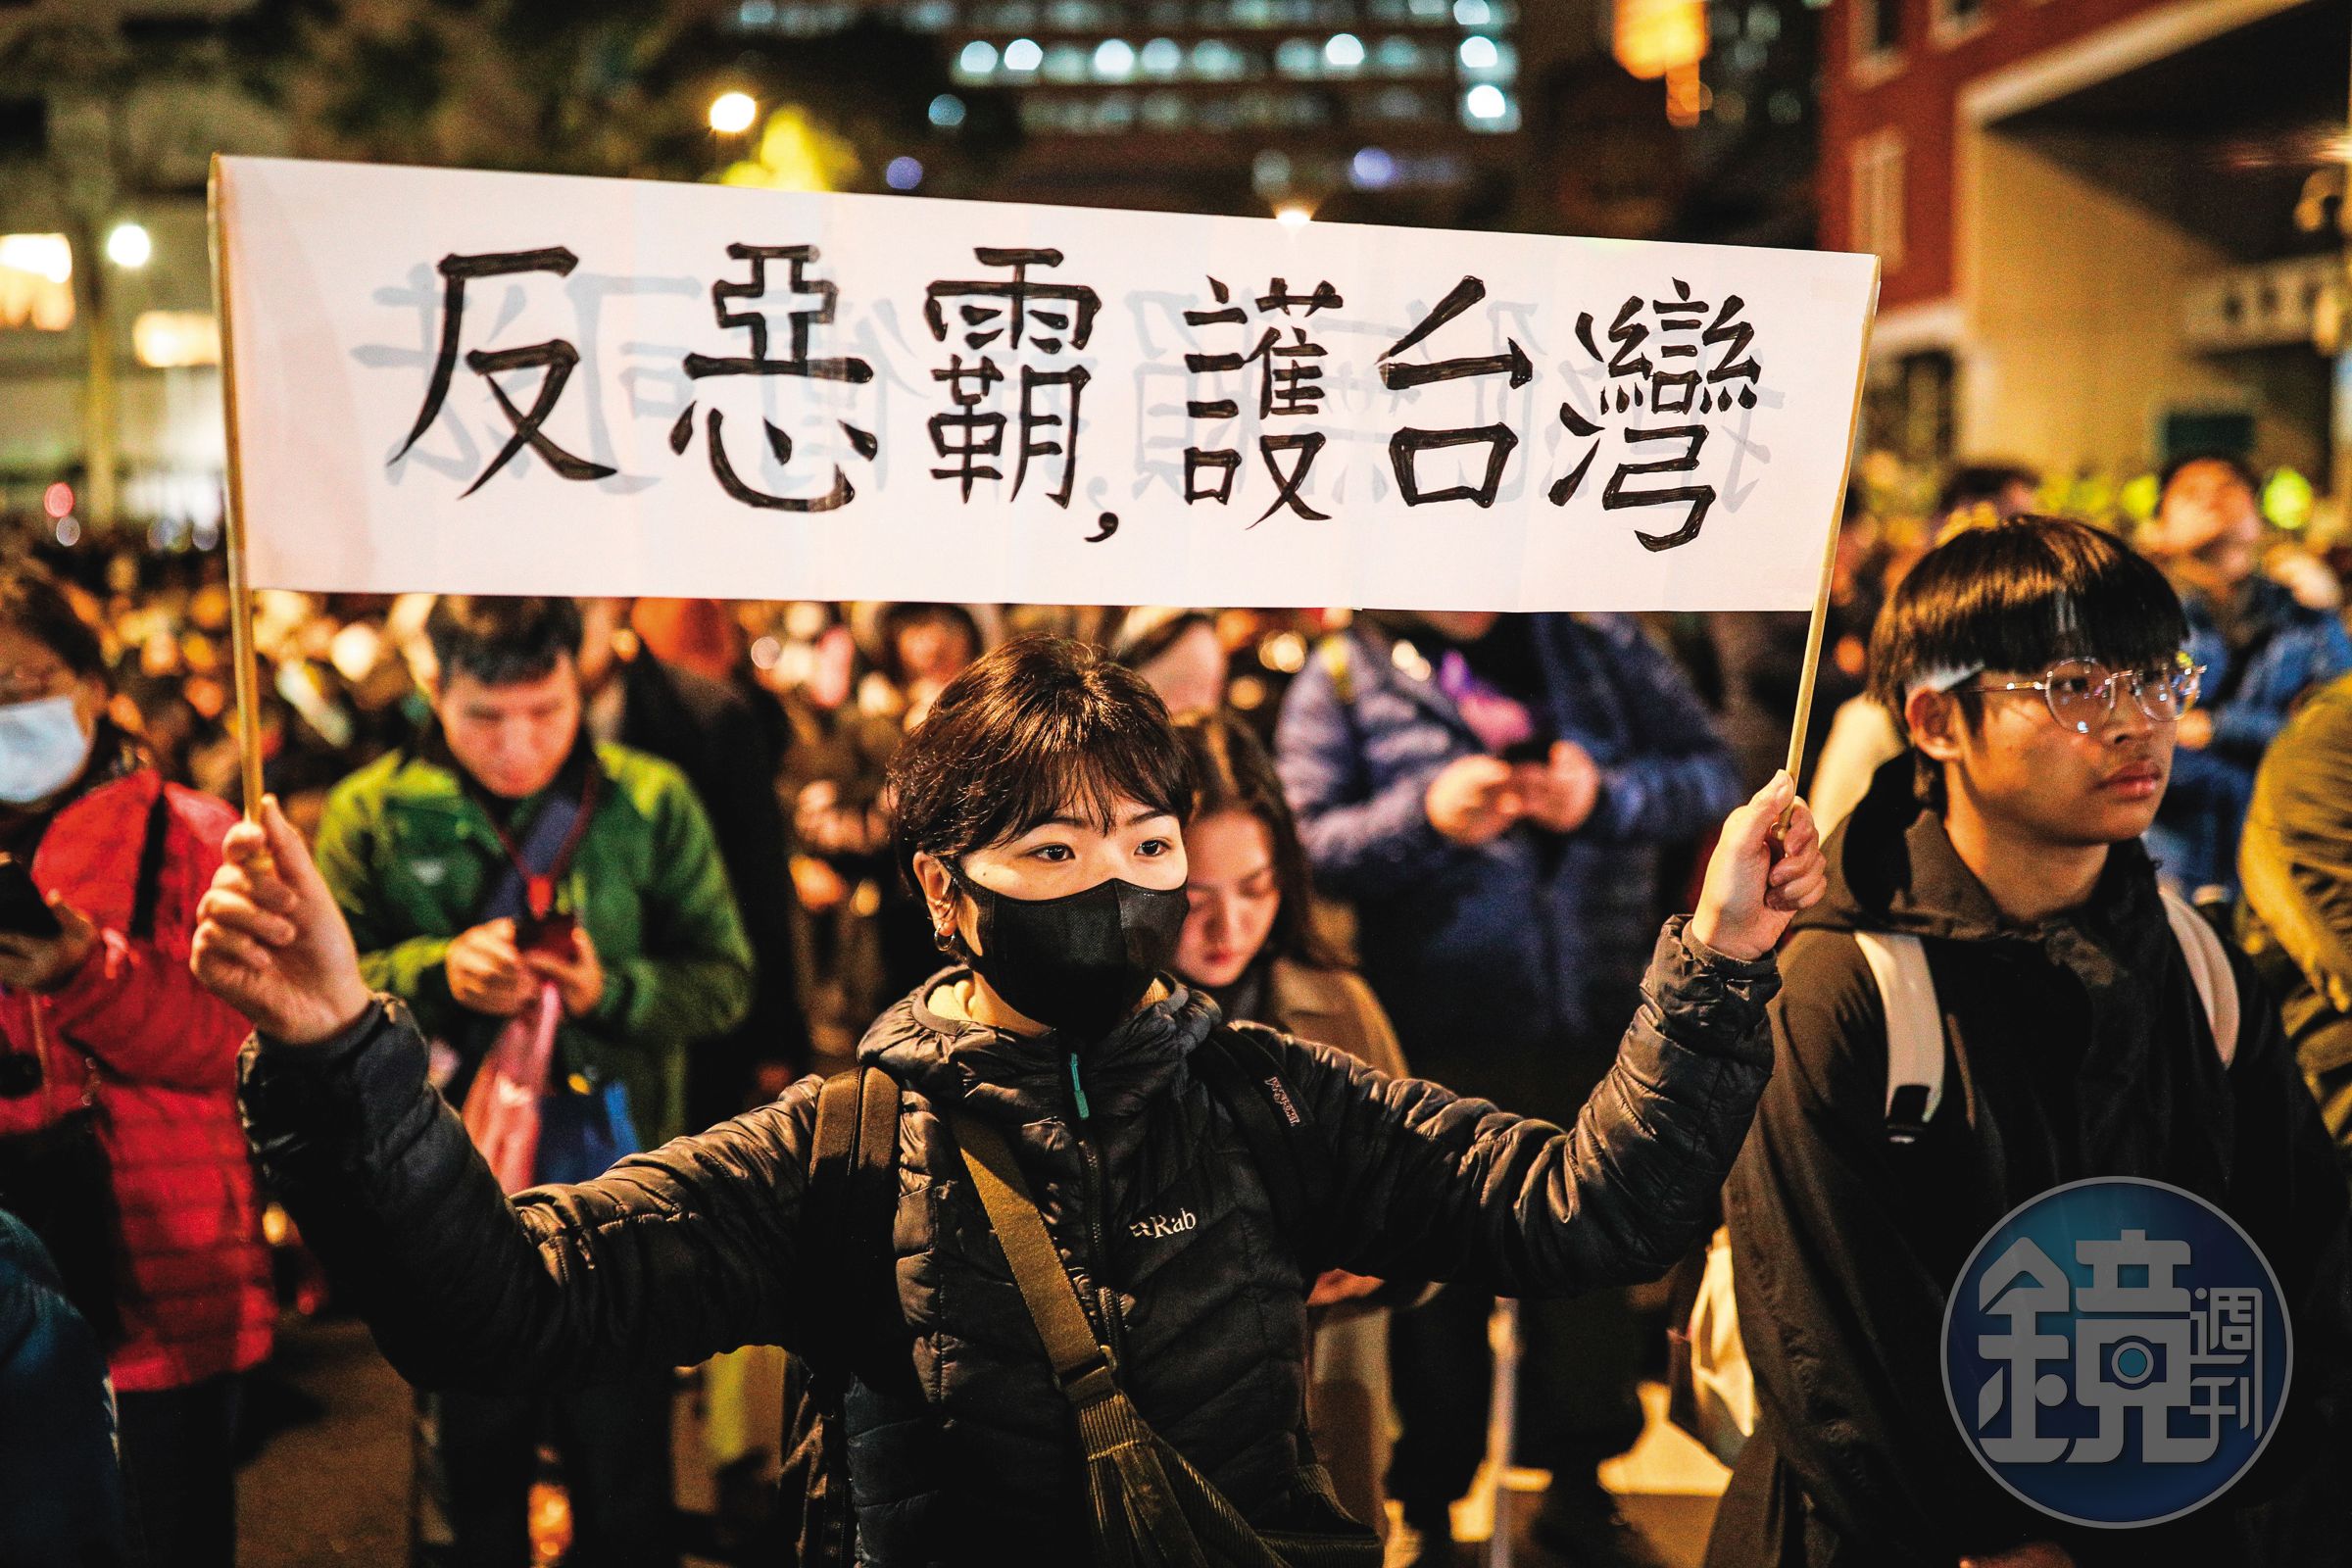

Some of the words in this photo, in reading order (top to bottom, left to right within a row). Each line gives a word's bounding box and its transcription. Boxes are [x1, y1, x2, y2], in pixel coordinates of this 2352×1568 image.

[386, 241, 1763, 554] 反惡霸，護台灣
[1150, 1207, 1197, 1239] Rab
